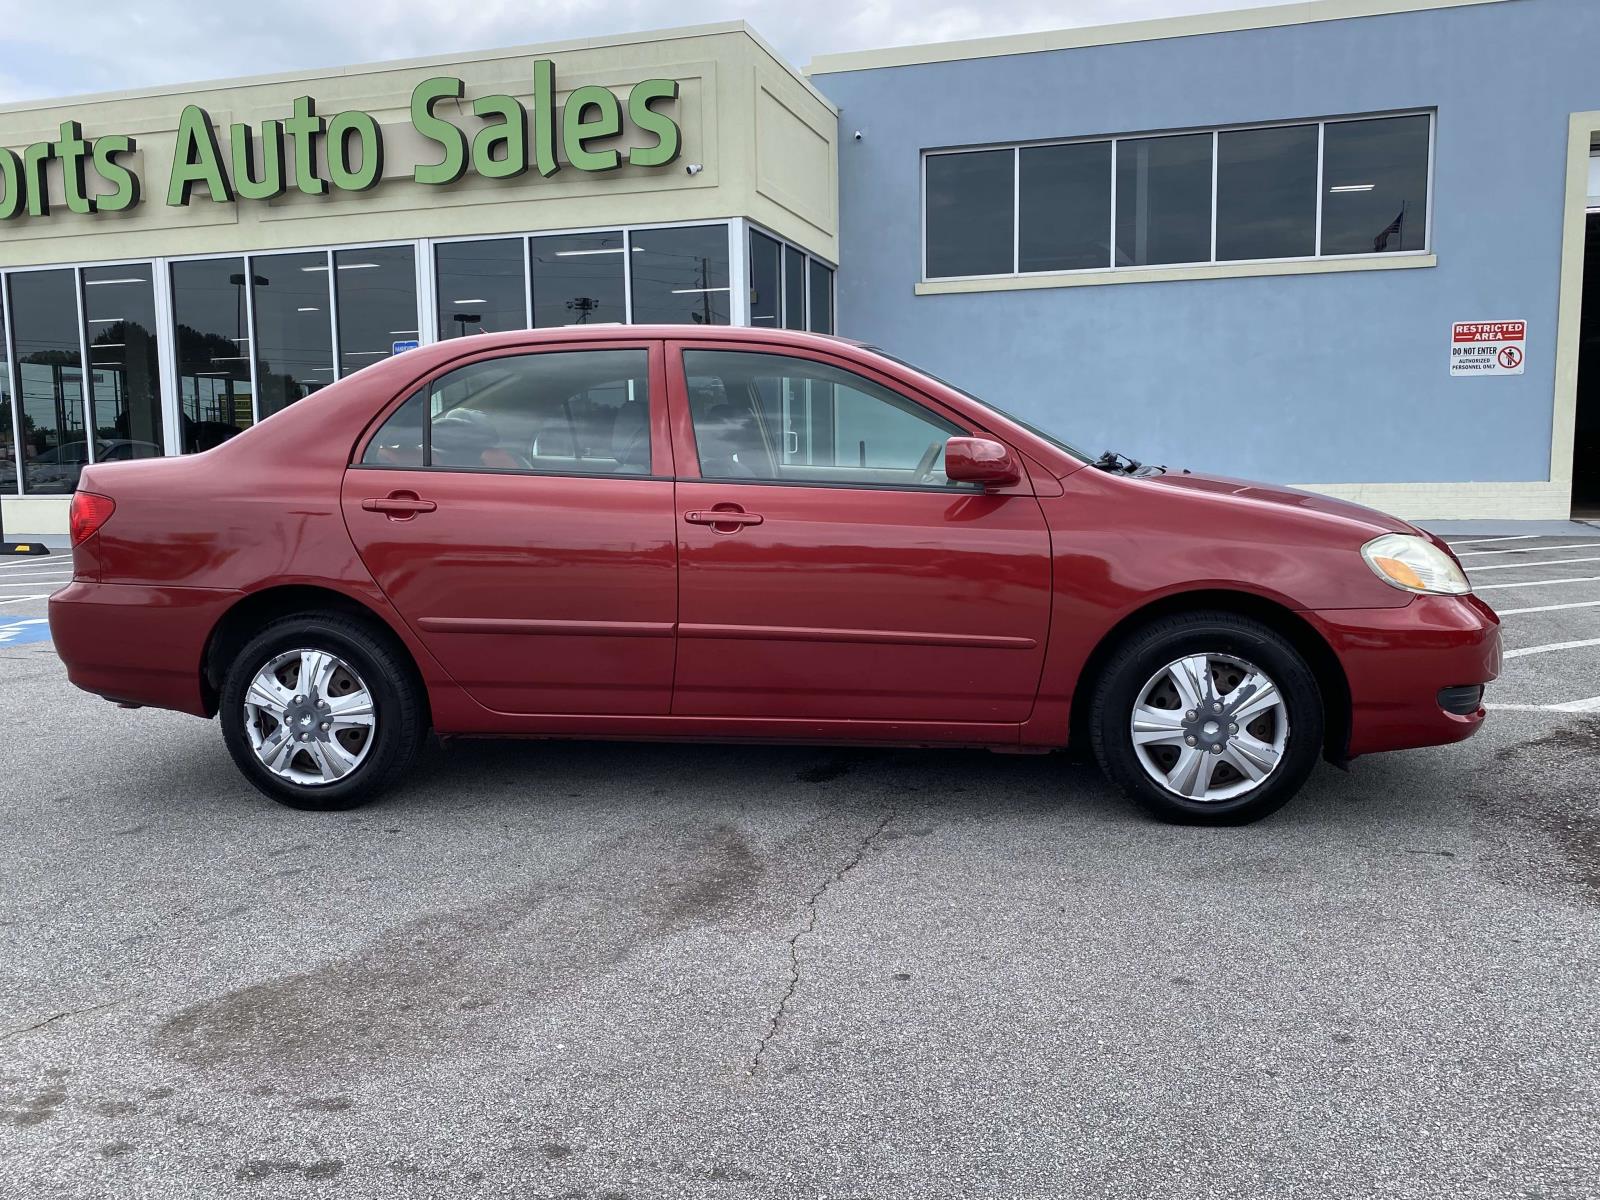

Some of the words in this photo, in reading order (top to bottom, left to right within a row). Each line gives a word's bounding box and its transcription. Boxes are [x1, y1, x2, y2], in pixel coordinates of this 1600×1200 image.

[166, 95, 384, 206] Auto
[410, 59, 682, 185] Sales
[1456, 323, 1522, 333] RESTRICTED
[1474, 332, 1503, 340] AREA
[1452, 347, 1462, 355] DO
[1463, 347, 1476, 355] NOT
[1477, 347, 1497, 355] ENTER
